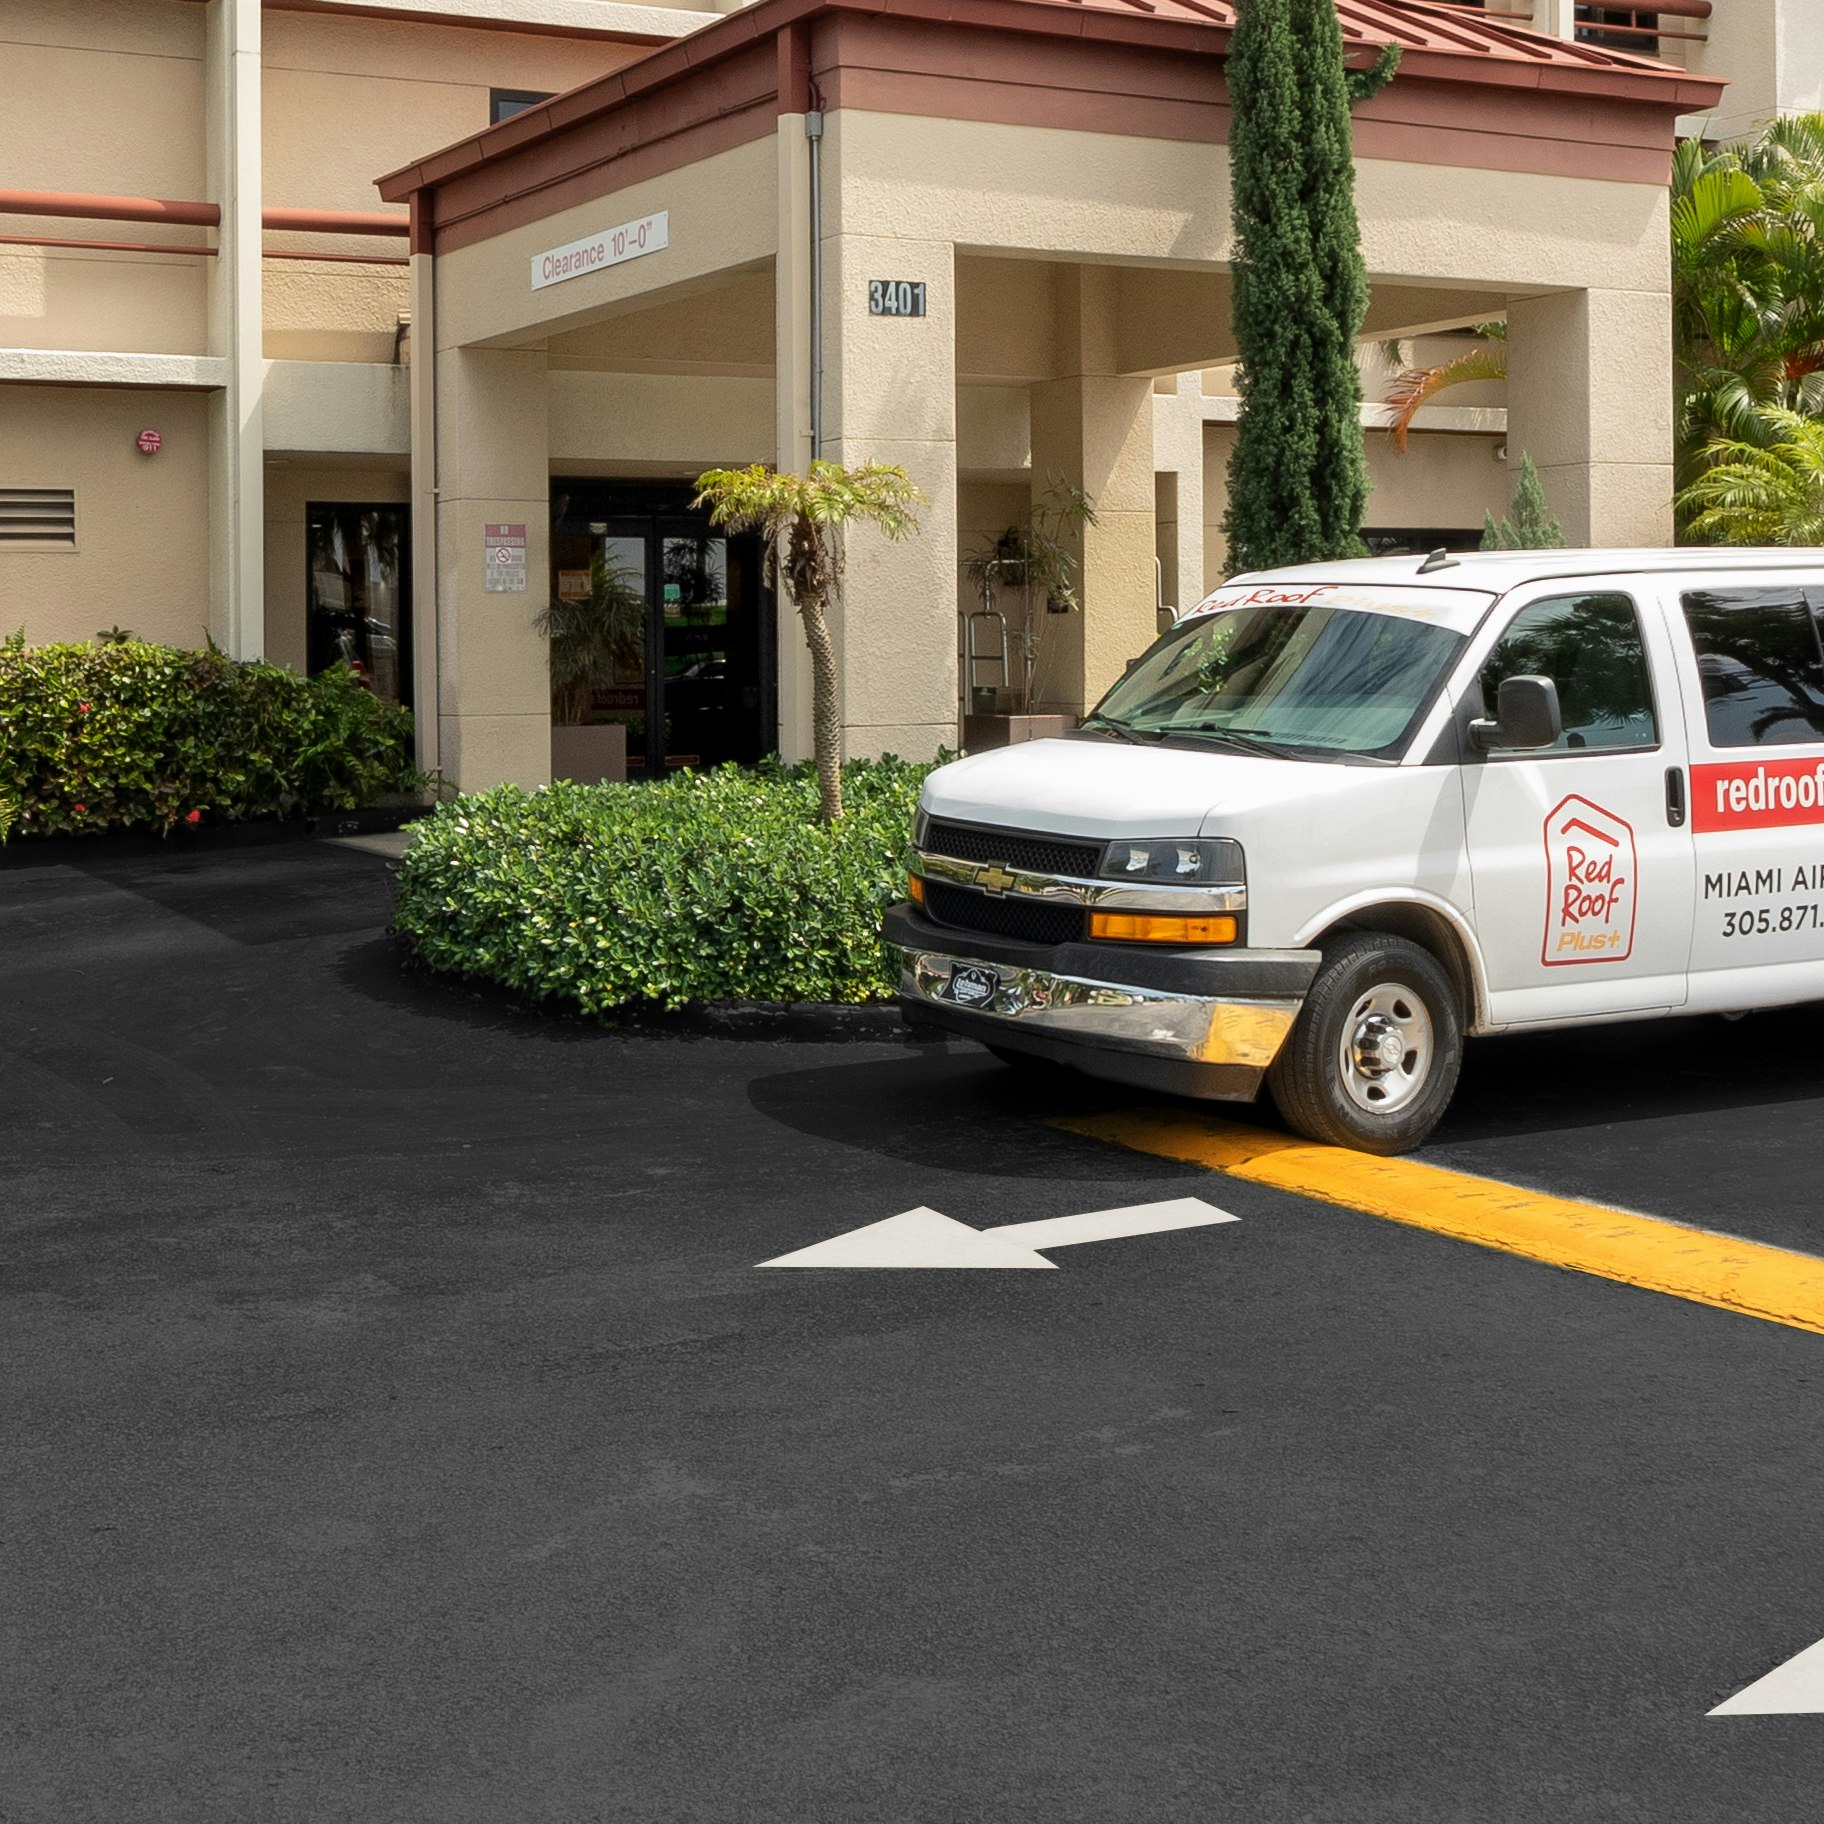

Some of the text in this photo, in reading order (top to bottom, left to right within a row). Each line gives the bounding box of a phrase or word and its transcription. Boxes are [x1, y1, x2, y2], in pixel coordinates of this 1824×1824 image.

[542, 242, 606, 281] Clearance
[869, 281, 925, 315] 3401
[1192, 594, 1247, 615] Red
[1243, 585, 1339, 607] Roof
[1566, 845, 1613, 885] Red
[1704, 867, 1782, 900] MIAMI
[1561, 877, 1625, 928] Roof
[1556, 929, 1621, 952] Plus+
